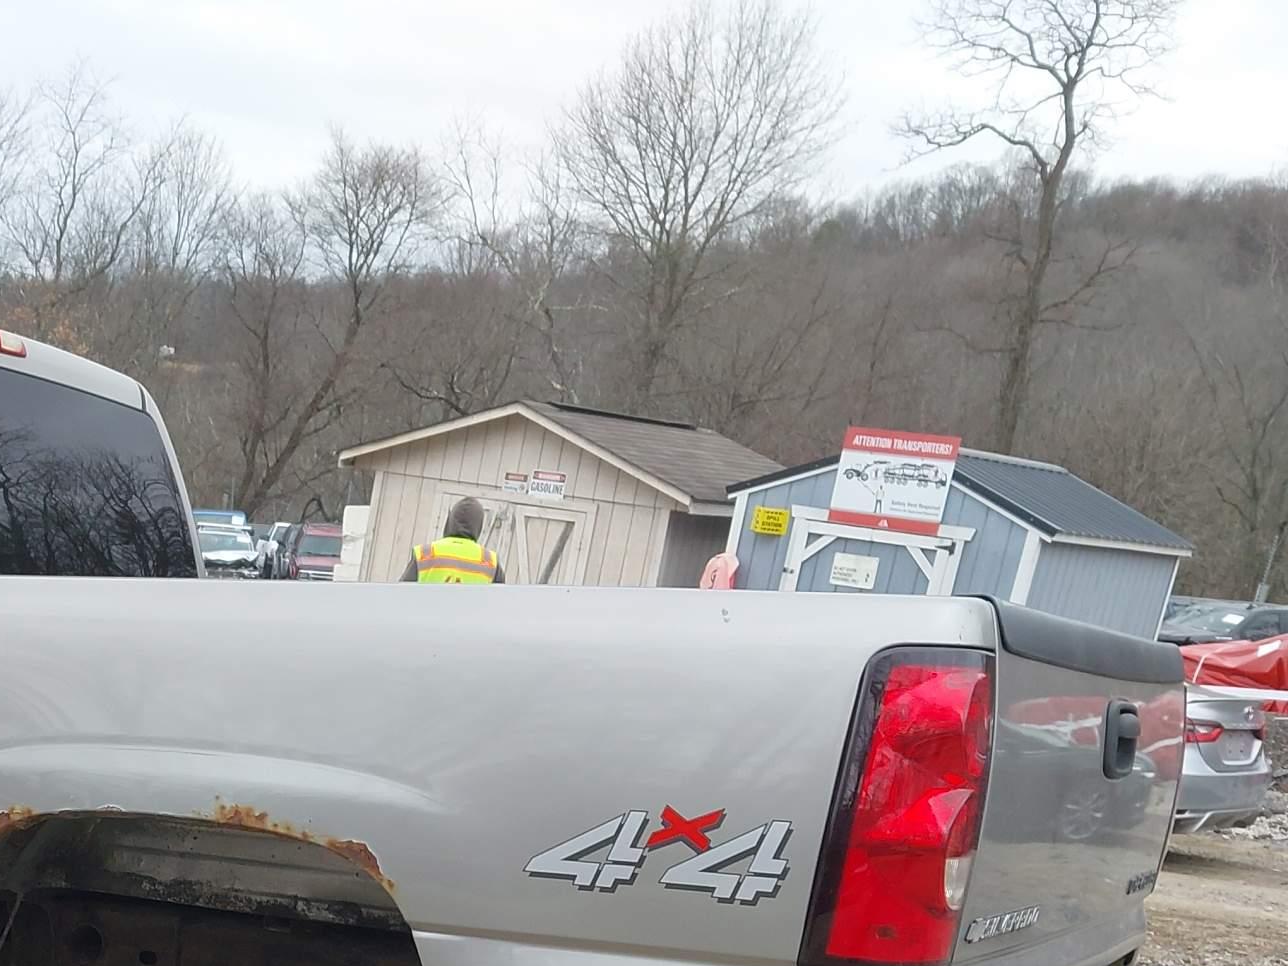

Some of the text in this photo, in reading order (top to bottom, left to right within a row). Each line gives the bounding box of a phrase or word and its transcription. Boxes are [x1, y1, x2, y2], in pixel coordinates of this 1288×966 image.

[852, 434, 953, 455] ATTENTION TRANSPORTERS!
[530, 481, 563, 496] GASOLINE
